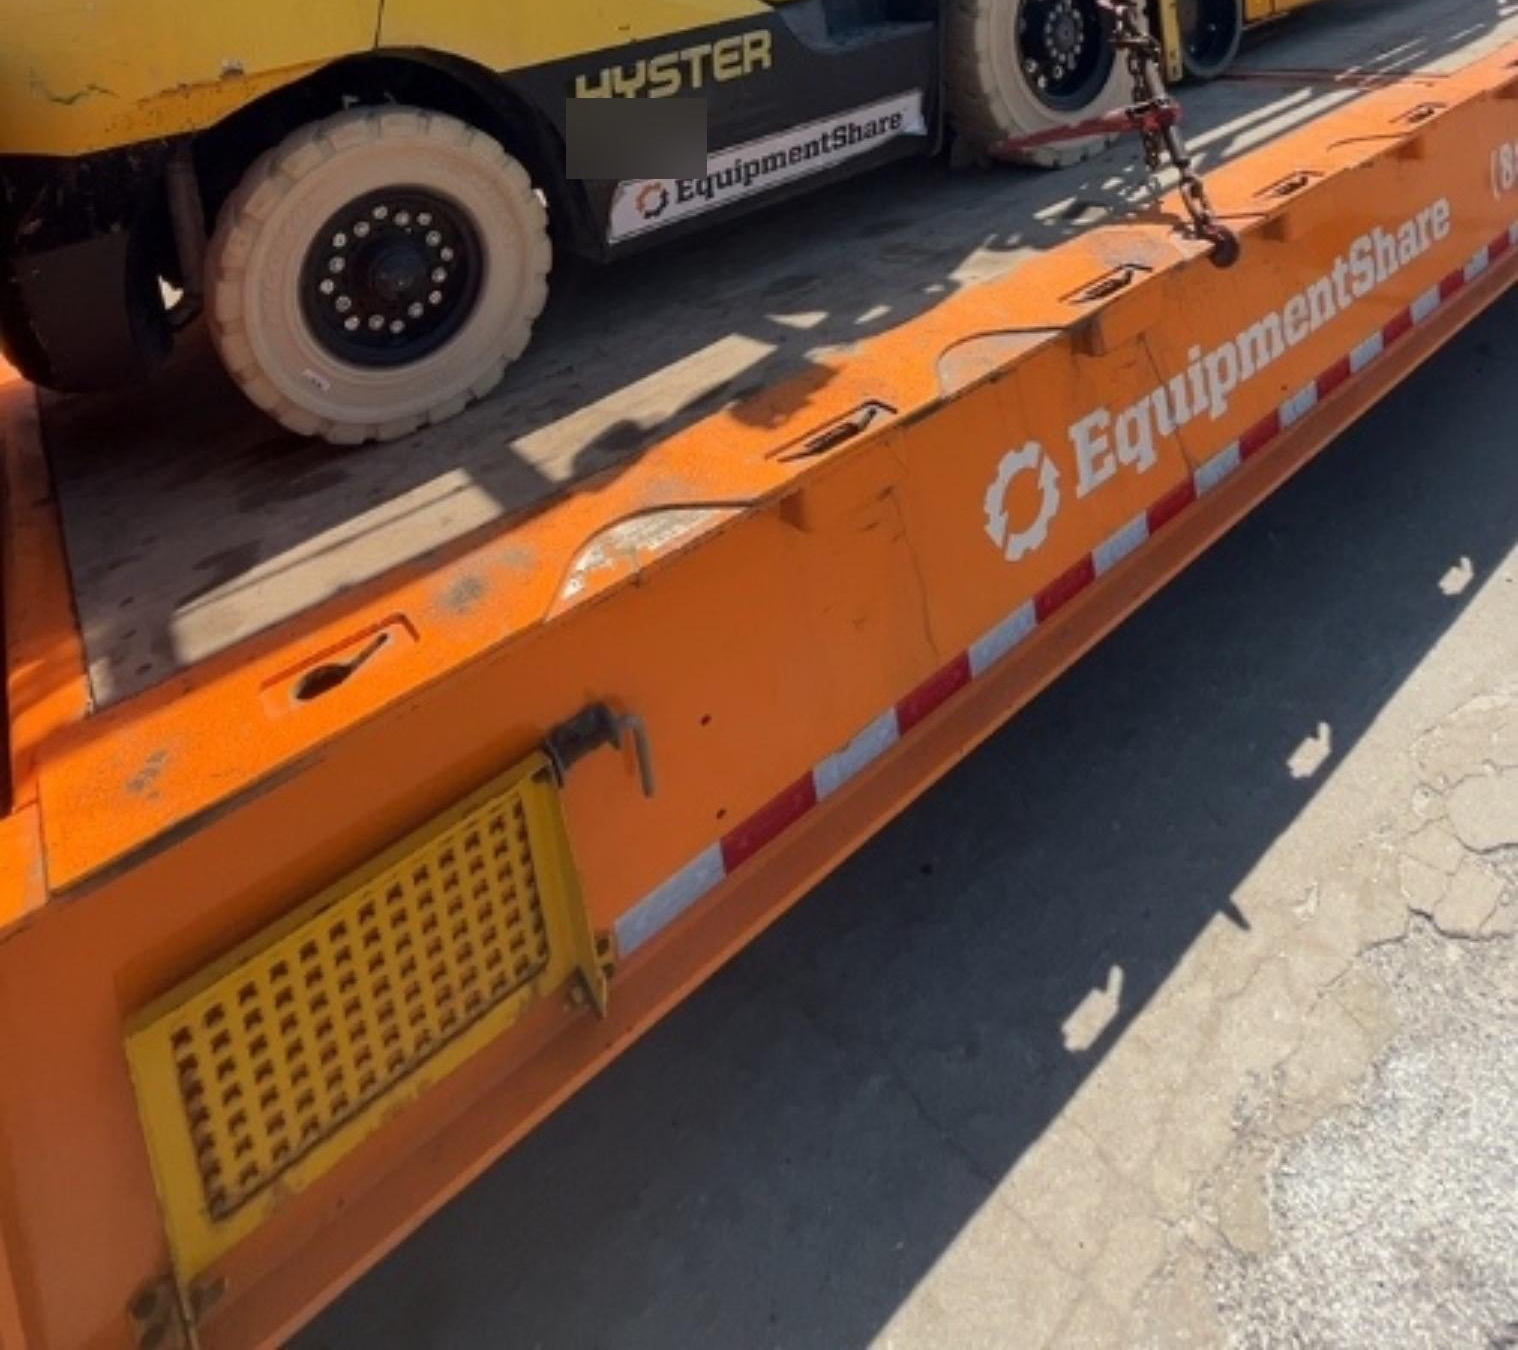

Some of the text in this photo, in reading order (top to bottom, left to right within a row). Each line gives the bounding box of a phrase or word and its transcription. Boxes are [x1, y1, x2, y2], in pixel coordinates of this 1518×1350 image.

[574, 29, 772, 99] HYSTER
[674, 111, 904, 204] EquipmentShare
[1067, 197, 1451, 499] EquipmentShare
